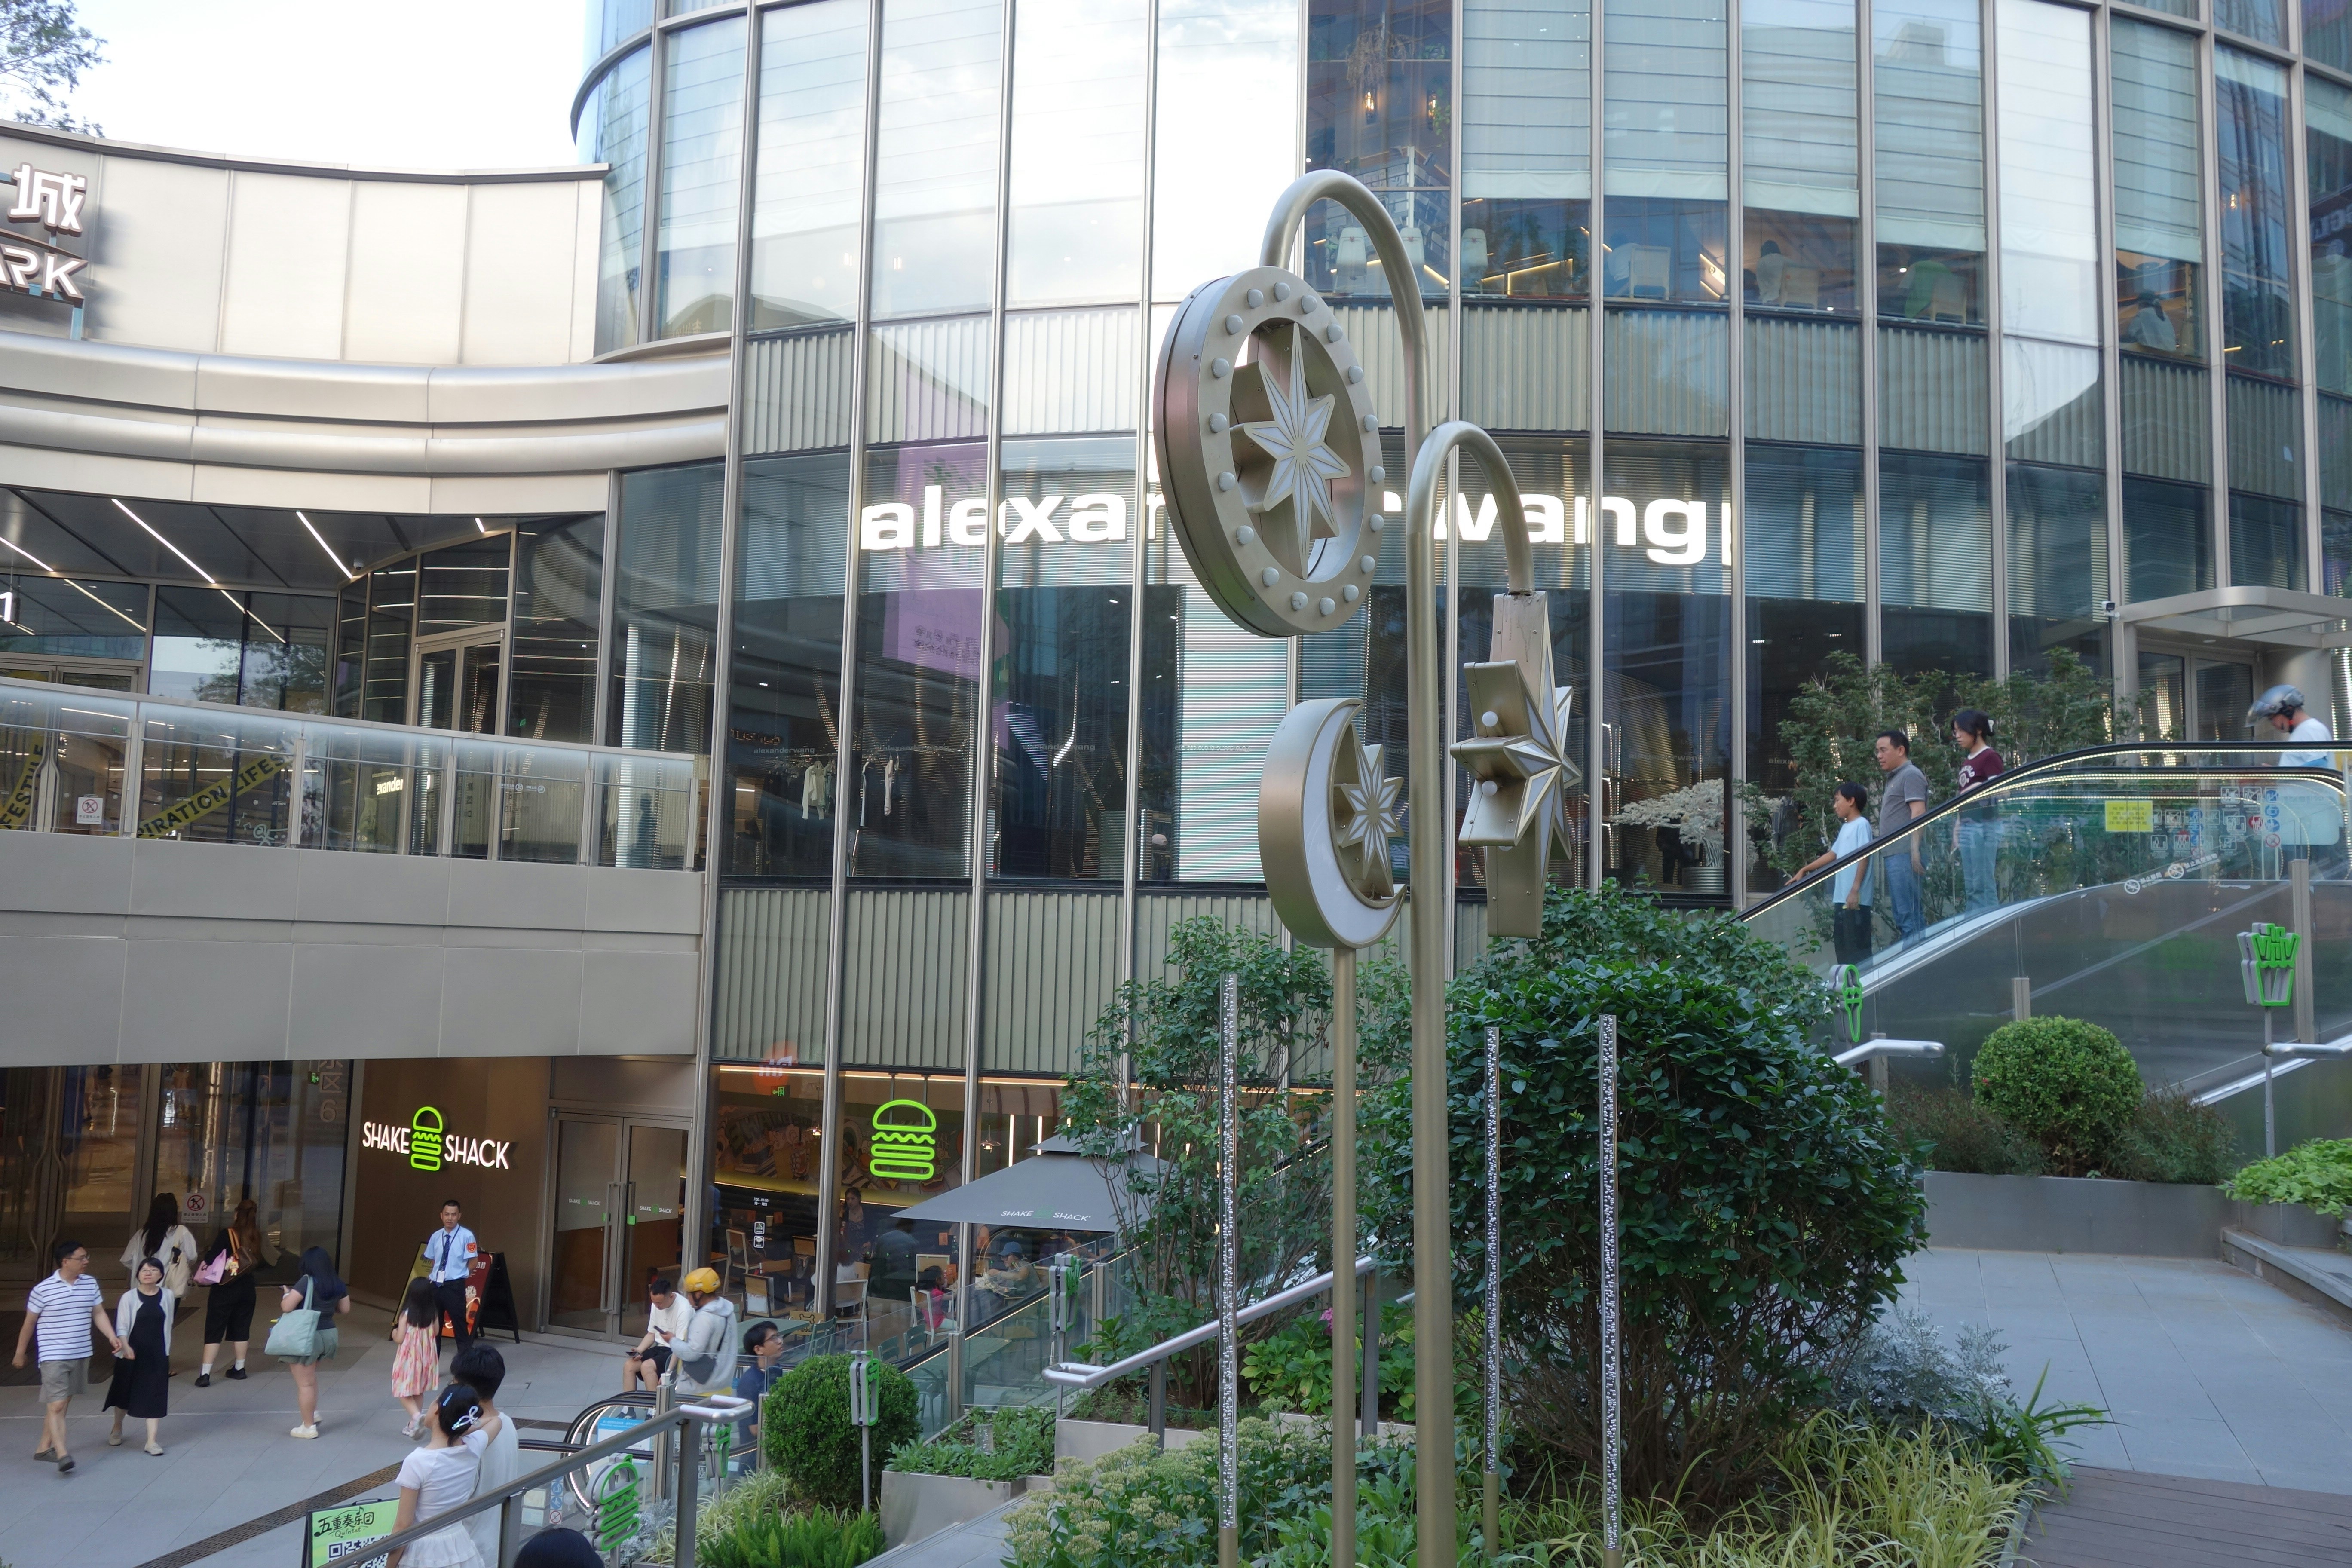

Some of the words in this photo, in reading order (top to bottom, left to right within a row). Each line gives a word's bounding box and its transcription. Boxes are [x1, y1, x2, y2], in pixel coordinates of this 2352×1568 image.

[9, 162, 86, 232] 城
[0, 245, 86, 297] RK
[861, 484, 1707, 565] alexawang
[362, 1121, 411, 1154] SHAKE
[444, 1134, 510, 1170] SHACK
[1053, 1212, 1088, 1222] SHACK
[314, 1511, 374, 1537] 五重奏乐团
[334, 1527, 362, 1538] Quintet
